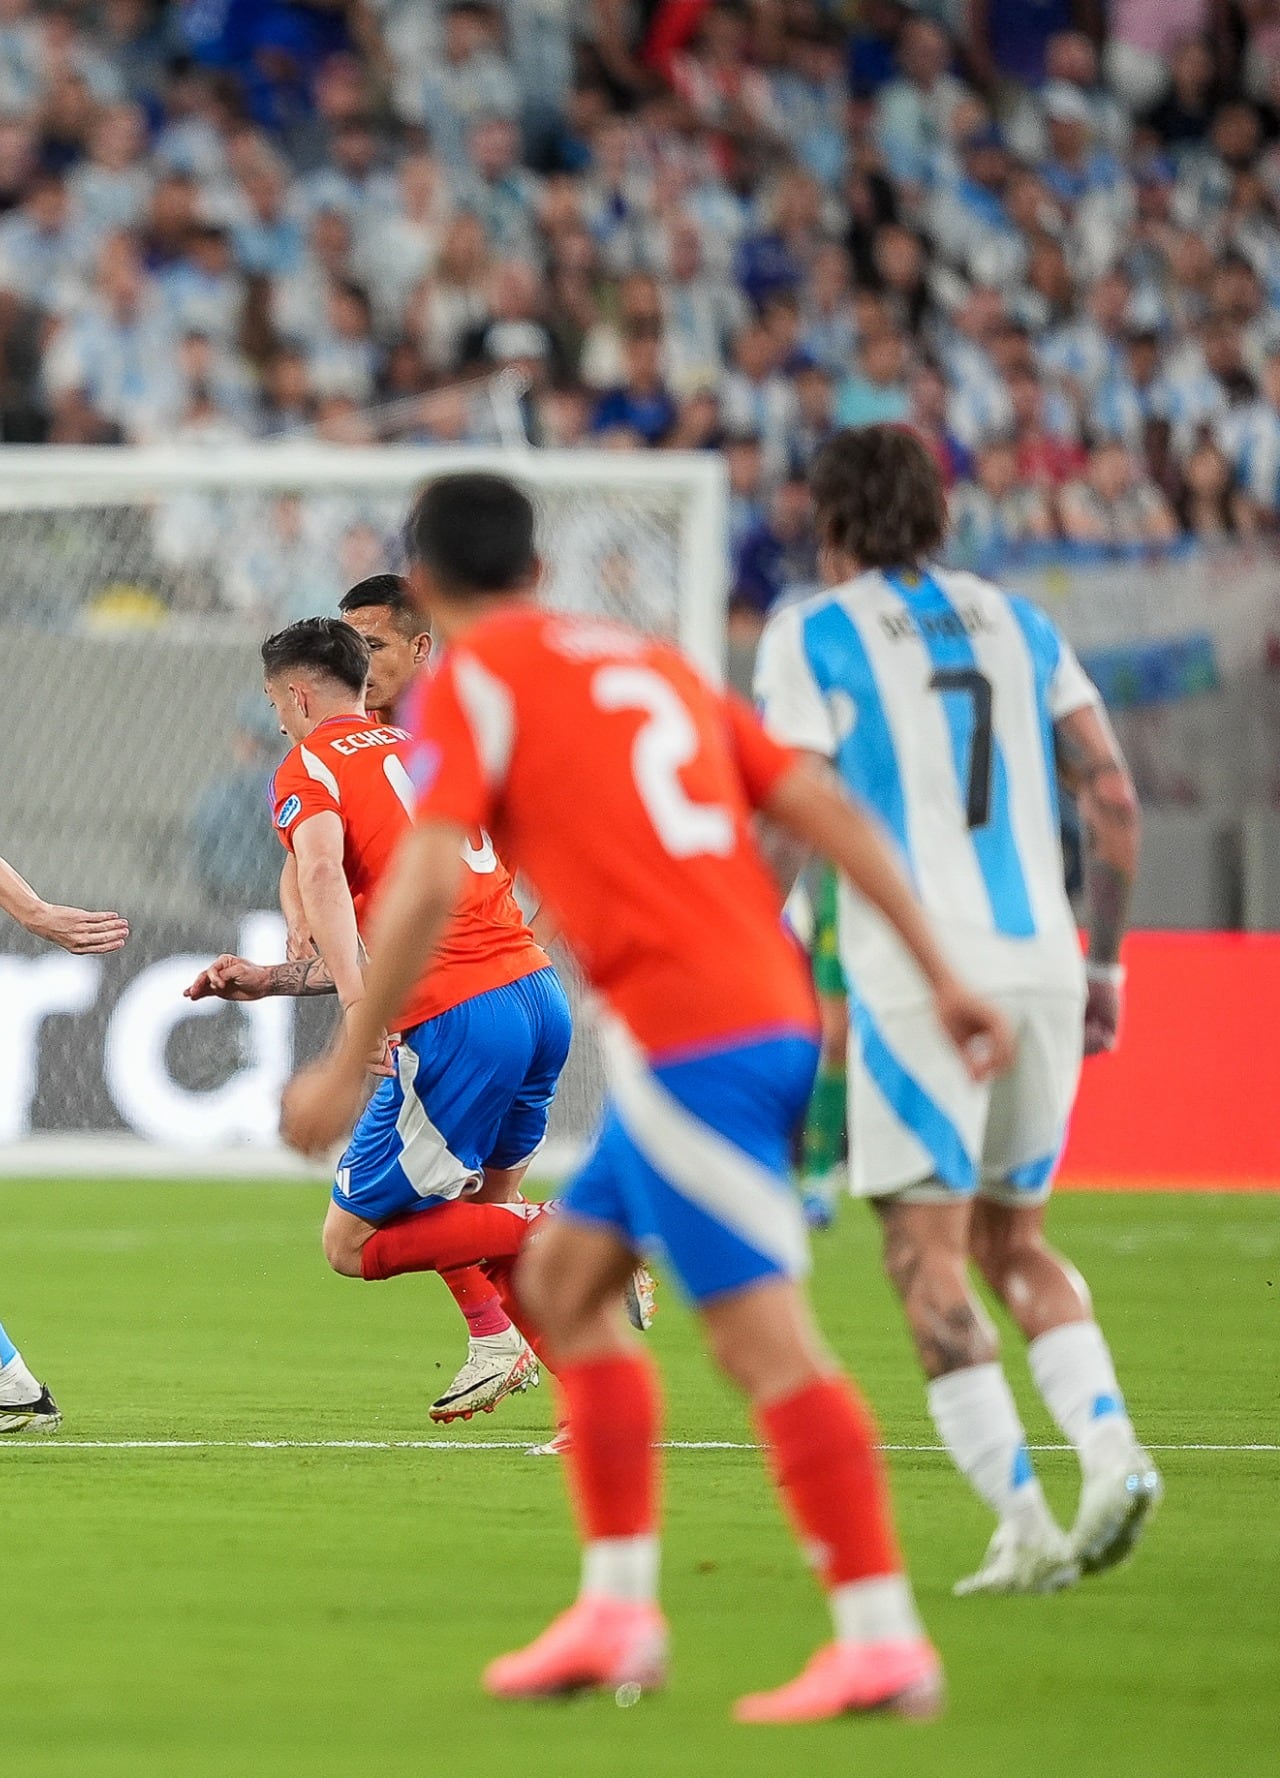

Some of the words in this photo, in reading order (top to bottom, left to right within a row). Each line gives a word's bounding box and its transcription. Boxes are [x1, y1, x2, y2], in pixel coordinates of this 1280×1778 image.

[329, 726, 412, 756] ECHEV
[590, 664, 736, 860] 2
[927, 669, 992, 828] 7
